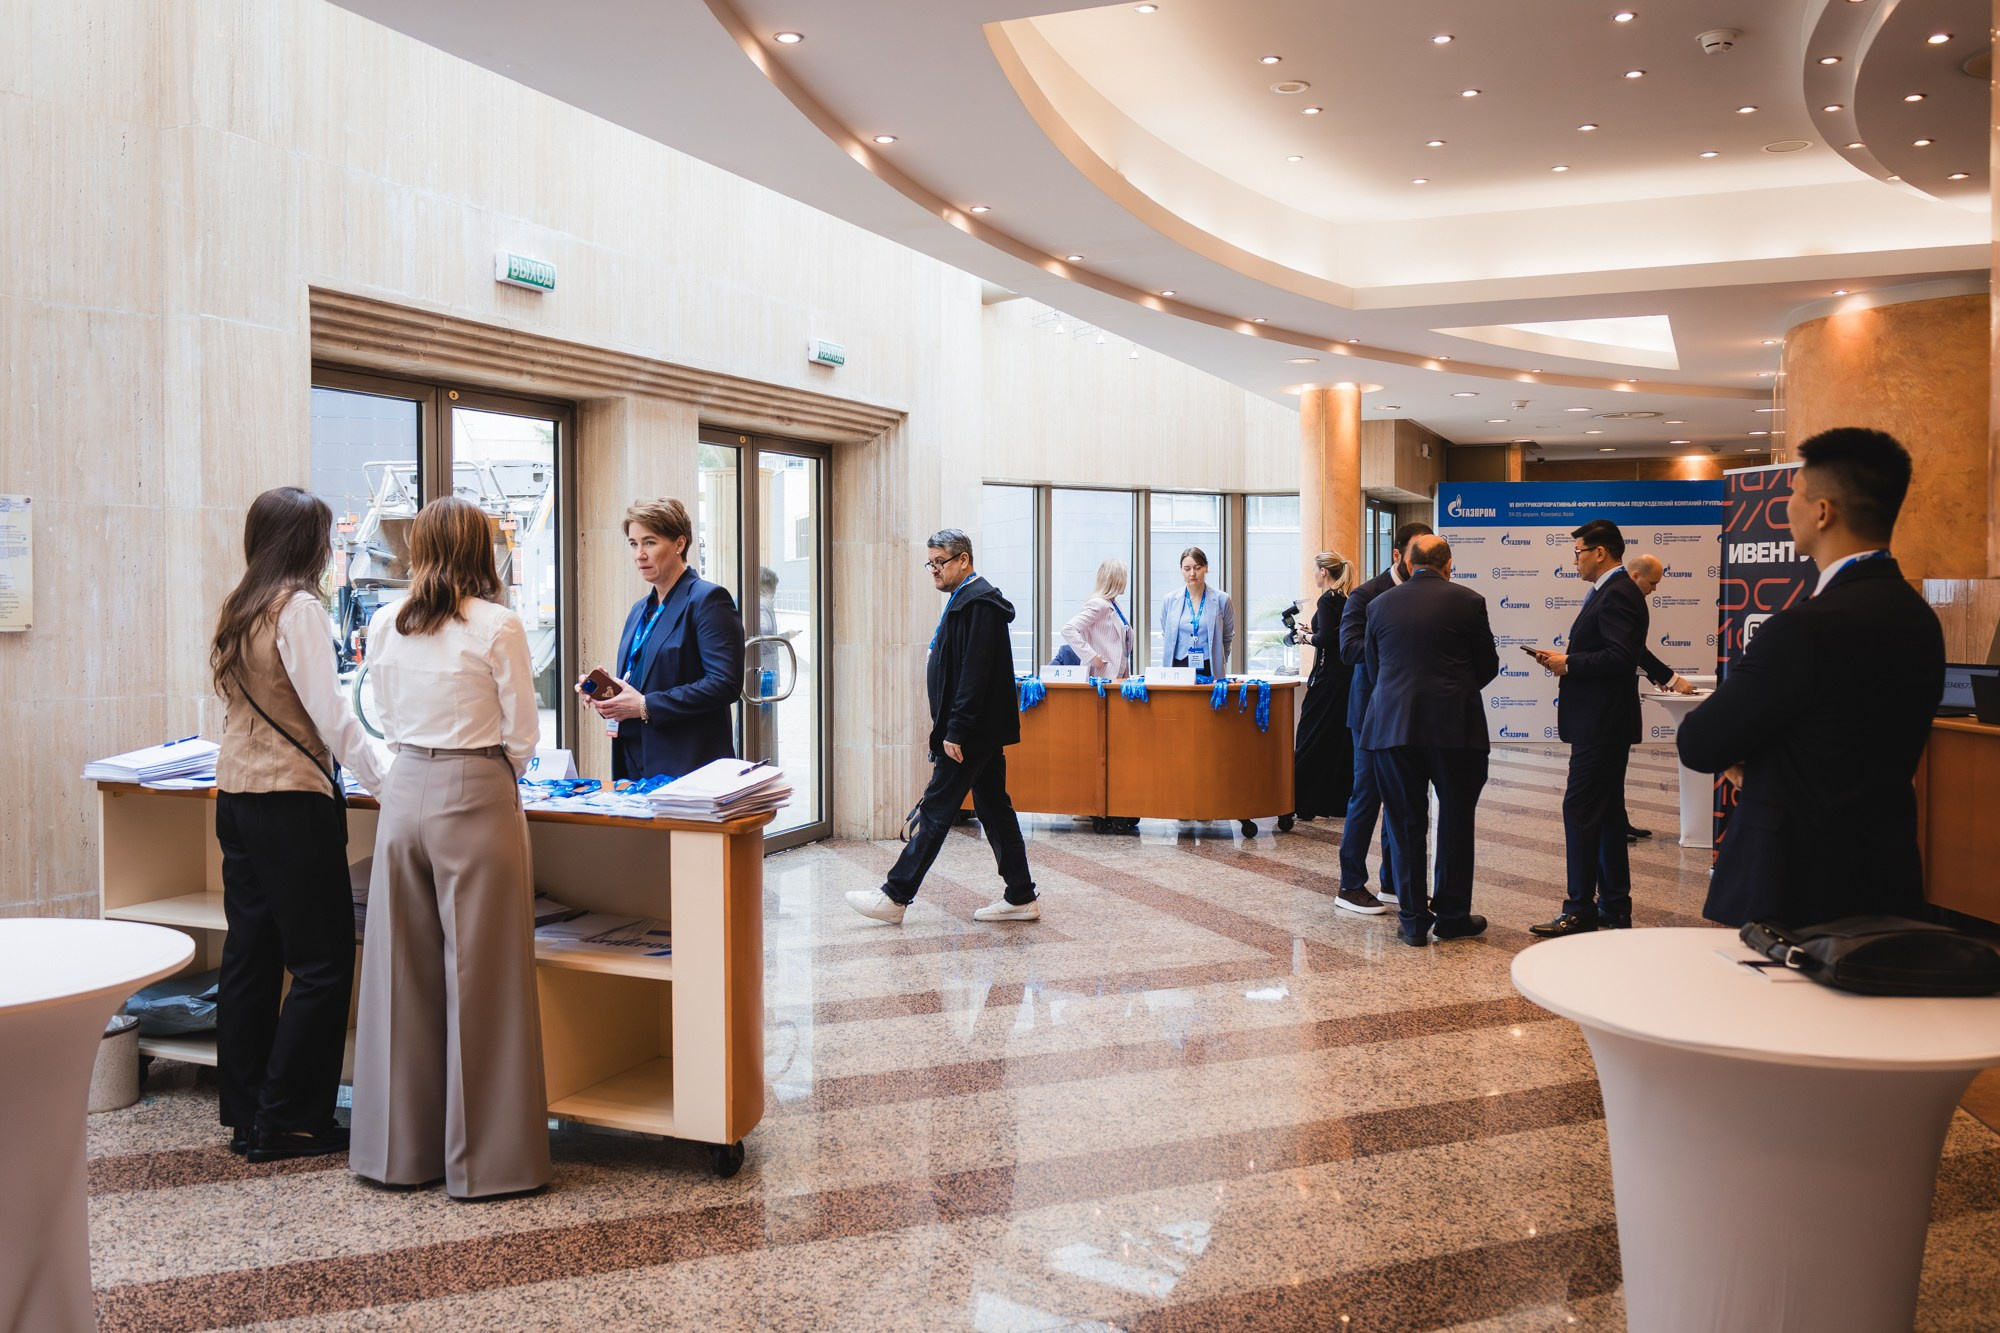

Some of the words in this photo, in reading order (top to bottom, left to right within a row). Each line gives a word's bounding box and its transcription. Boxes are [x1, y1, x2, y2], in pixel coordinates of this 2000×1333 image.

[511, 256, 553, 287] ВЫХОД
[1462, 508, 1496, 518] ГАЗПРОМ
[1728, 541, 1817, 564] ИВЕНТ
[529, 757, 540, 771] Я
